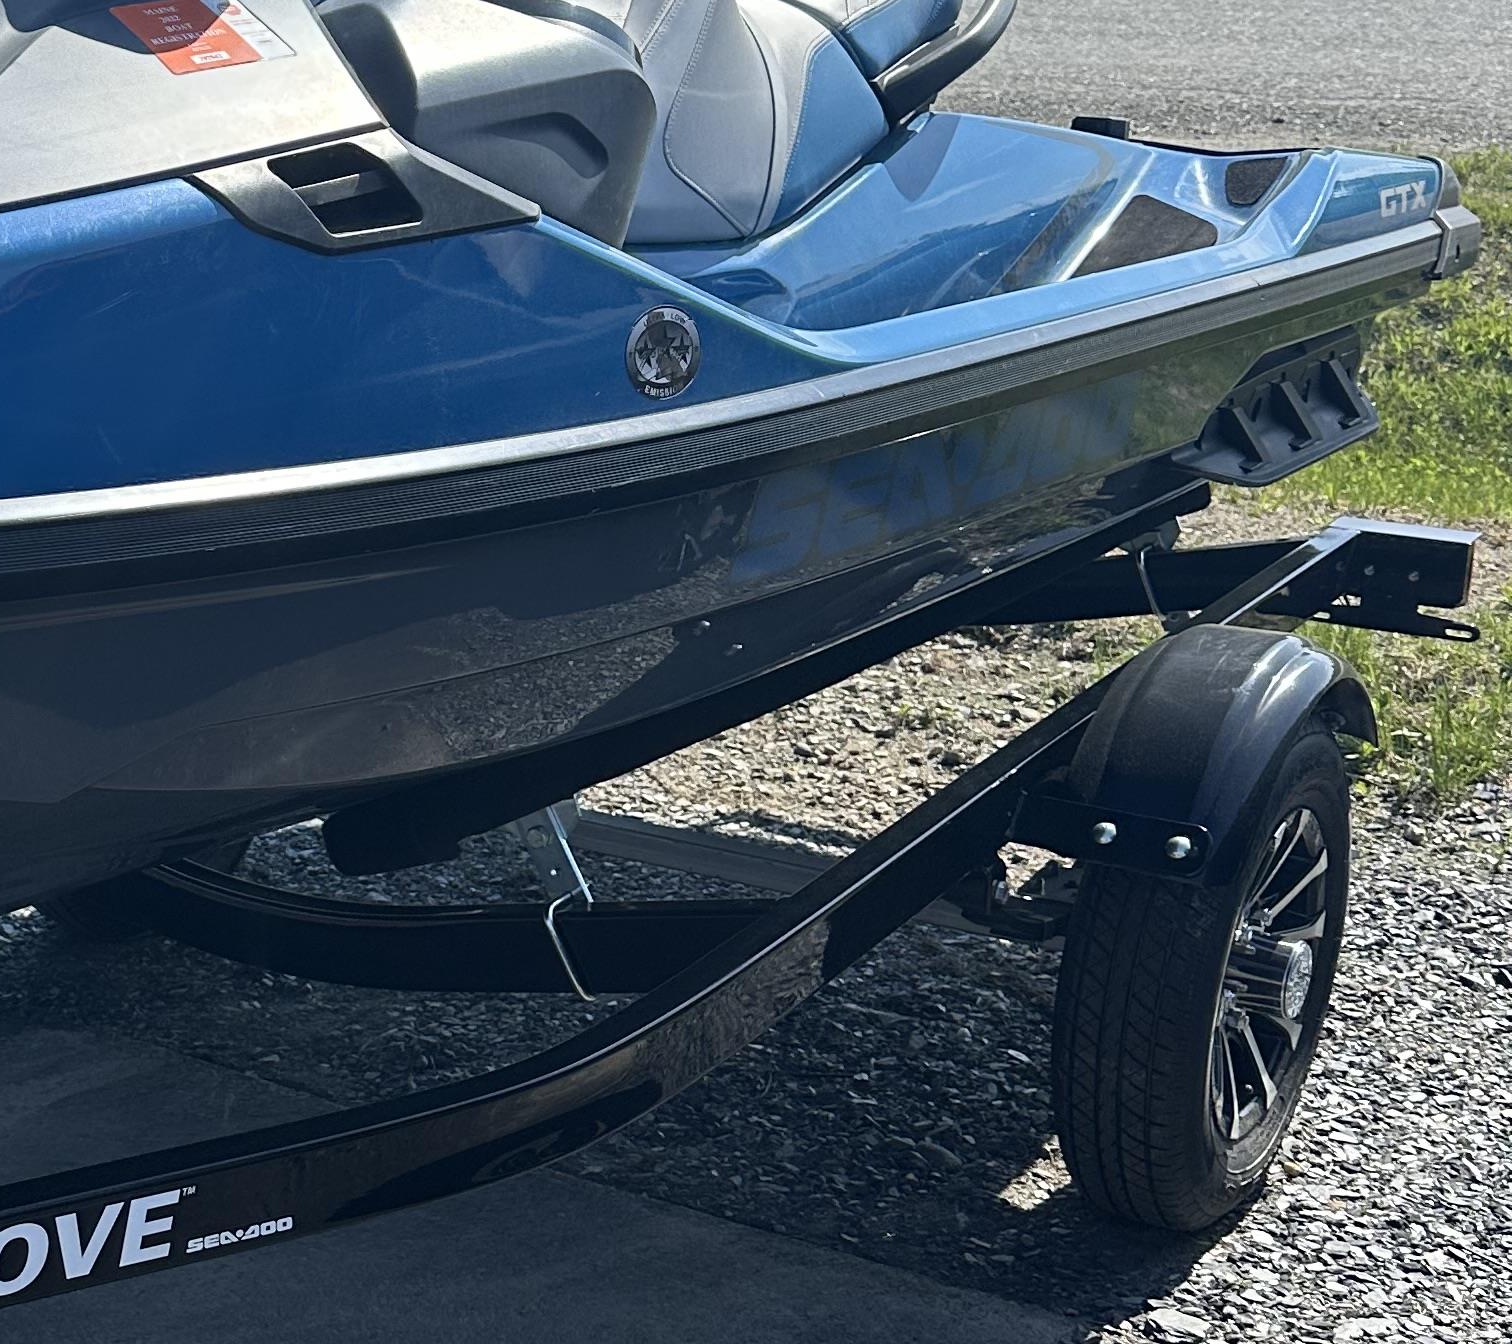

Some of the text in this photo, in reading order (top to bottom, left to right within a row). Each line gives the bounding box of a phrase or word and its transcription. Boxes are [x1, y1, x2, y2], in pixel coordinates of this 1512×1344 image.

[143, 4, 177, 16] MAINE
[165, 21, 194, 33] BOAT
[150, 26, 228, 47] REGISTRATION
[1380, 180, 1426, 217] GTX
